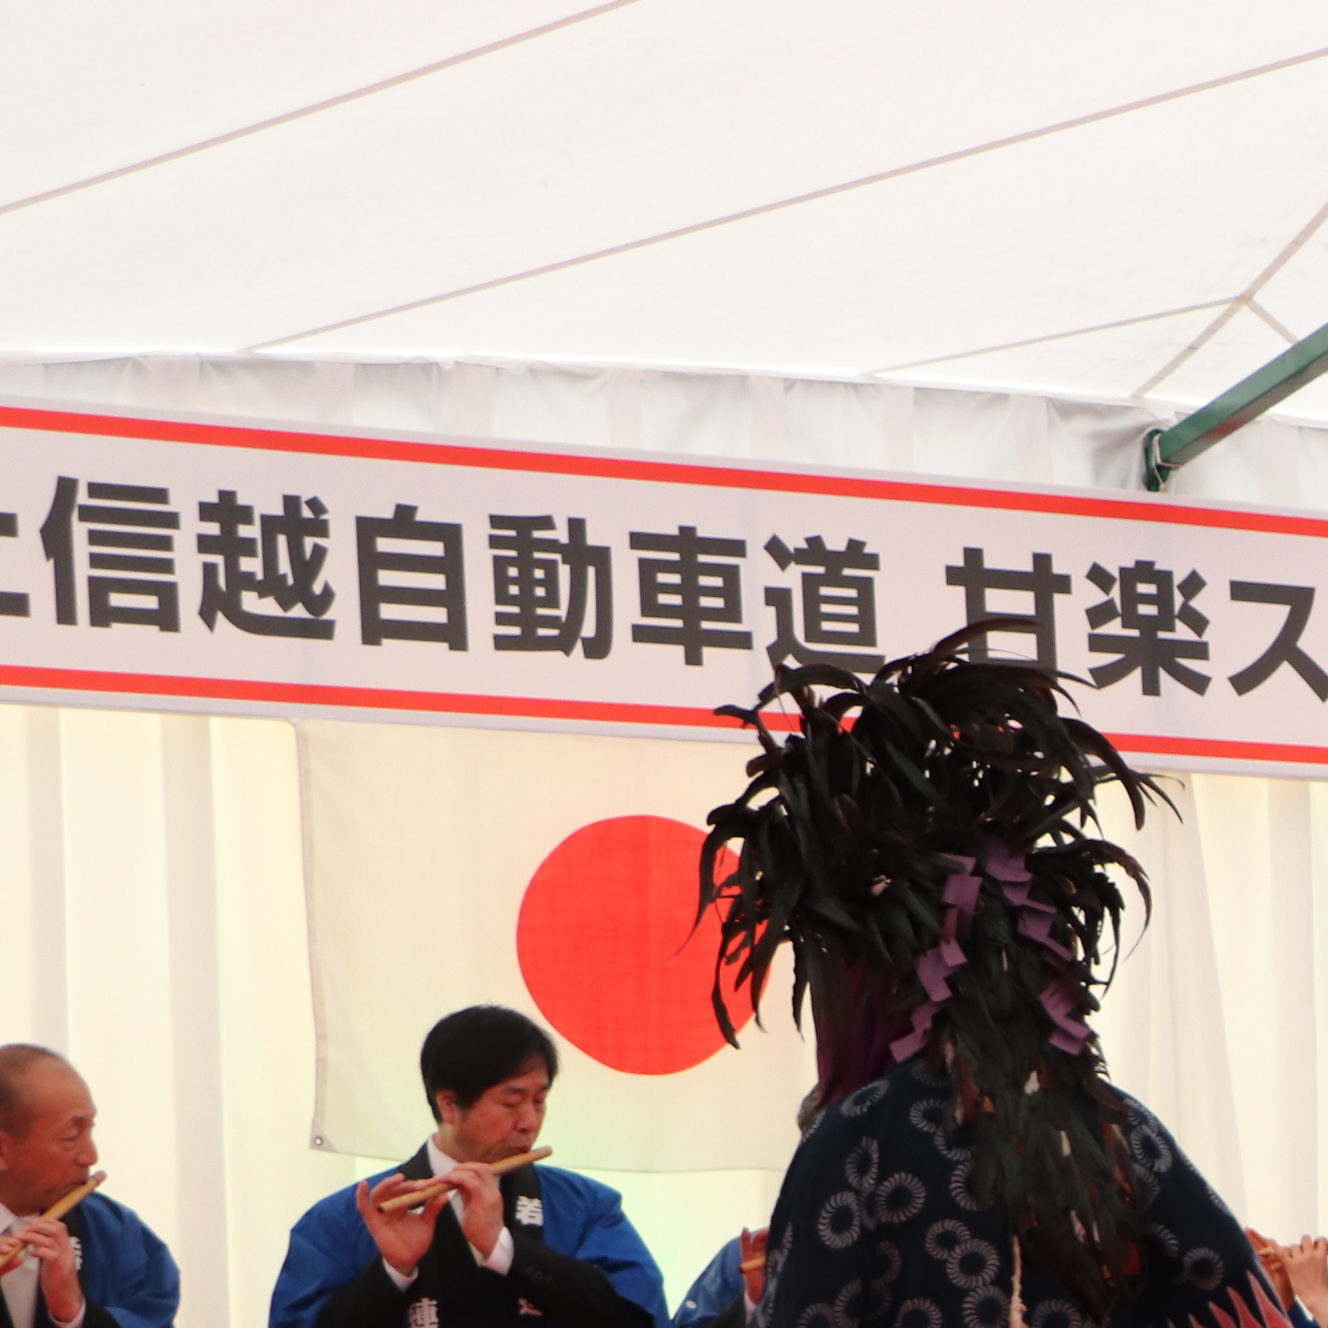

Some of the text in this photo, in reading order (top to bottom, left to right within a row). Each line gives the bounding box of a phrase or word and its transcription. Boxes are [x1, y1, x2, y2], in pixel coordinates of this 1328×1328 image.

[0, 474, 887, 675] 信越自動車道
